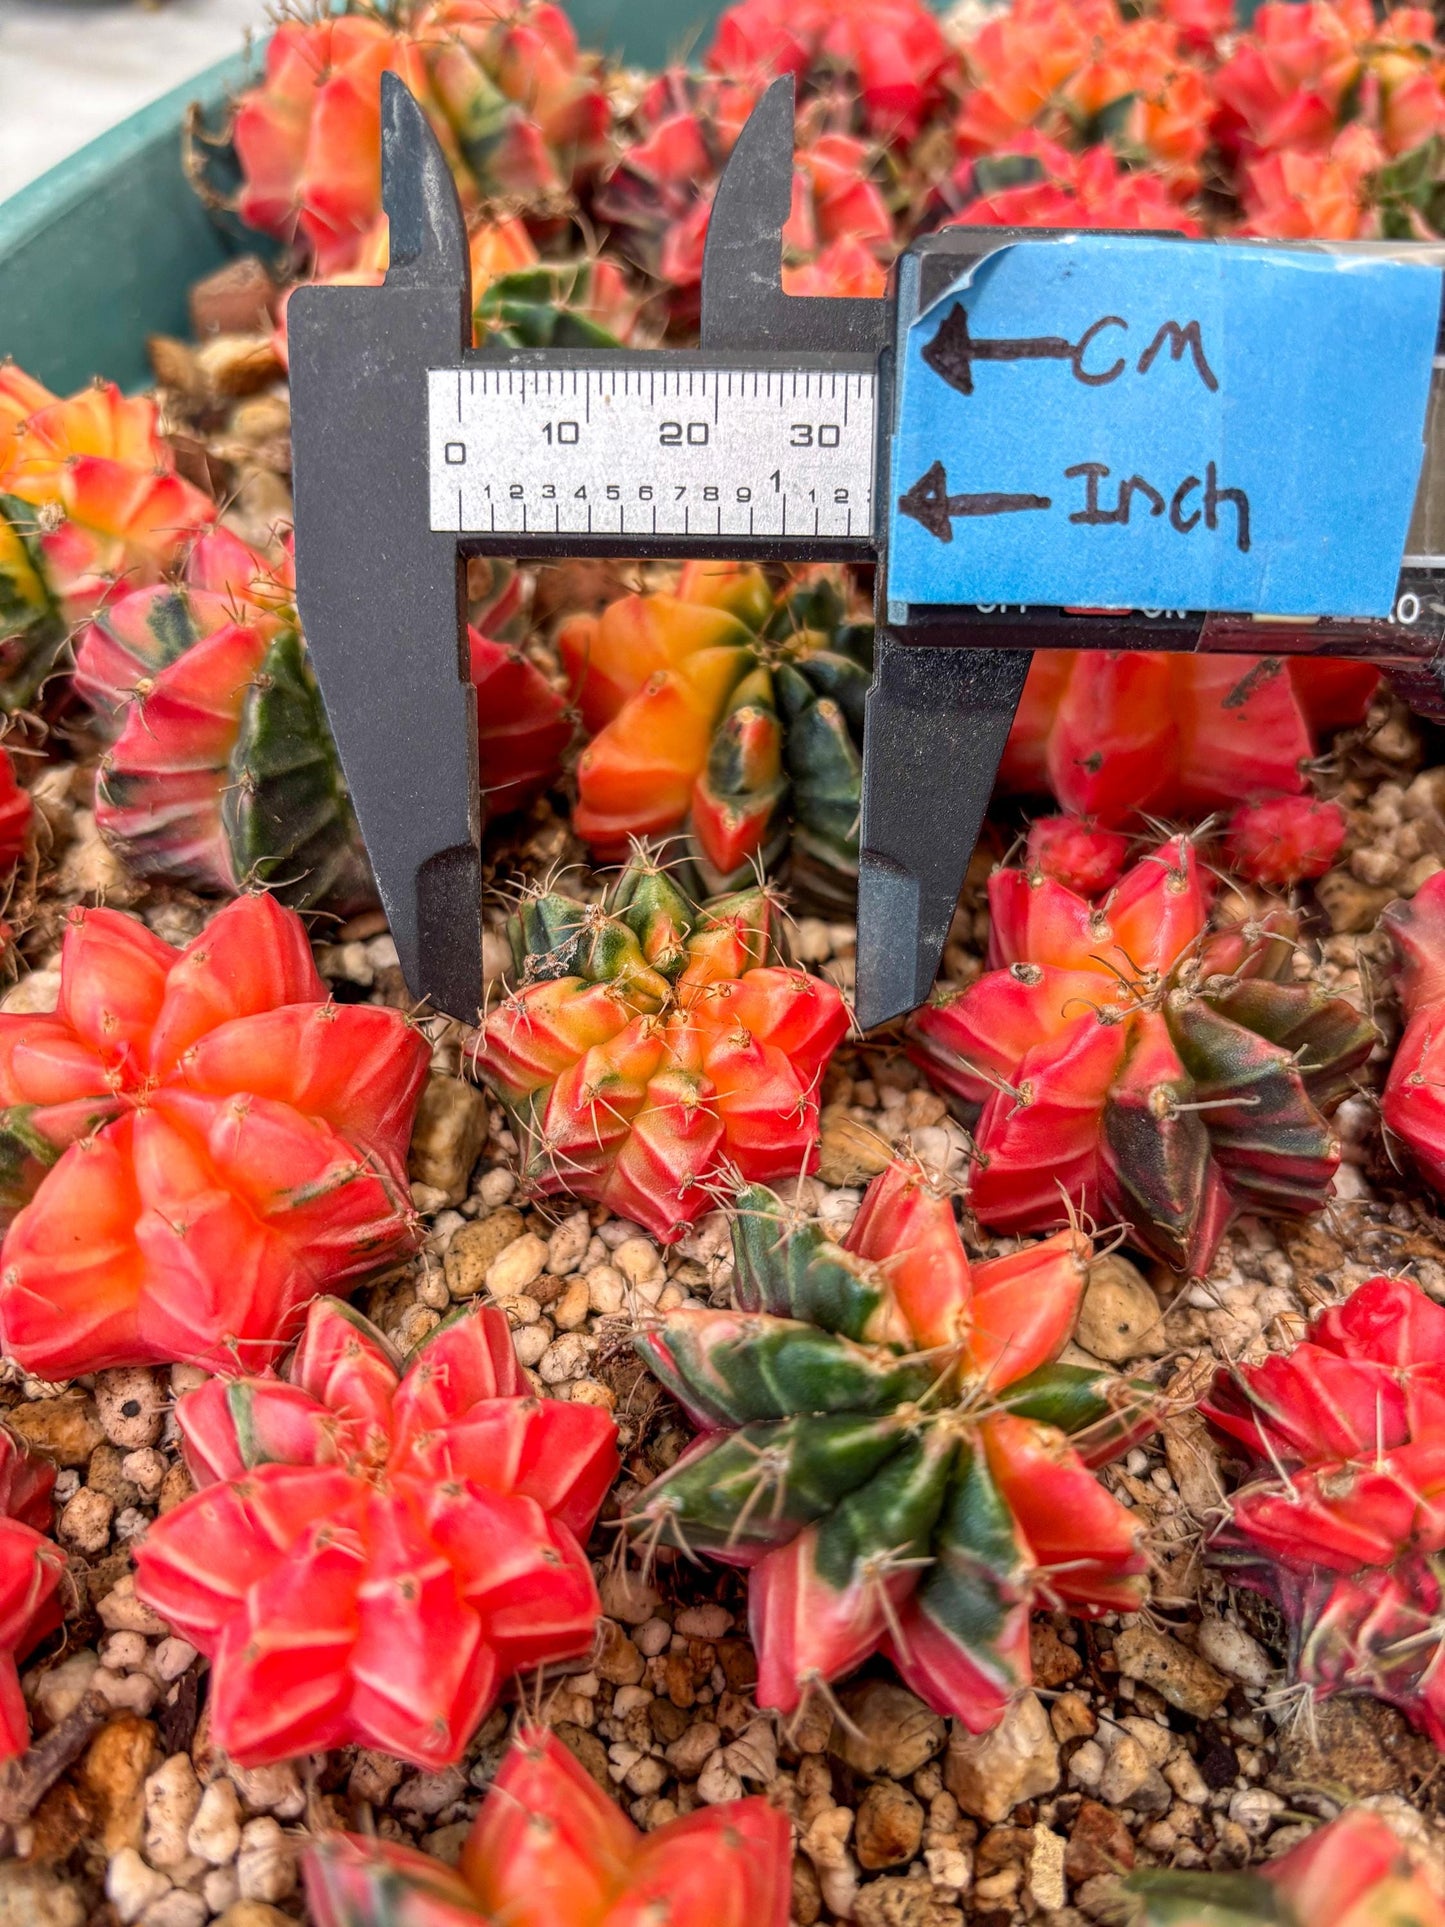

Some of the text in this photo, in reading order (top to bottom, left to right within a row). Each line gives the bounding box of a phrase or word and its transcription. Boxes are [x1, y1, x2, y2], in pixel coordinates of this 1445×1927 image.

[542, 421, 840, 448] 10 20 30
[445, 442, 466, 465] 0
[484, 469, 849, 504] 1 2 3 4 5 6 7 8 9 1 1 2
[1064, 460, 1251, 553] Inch
